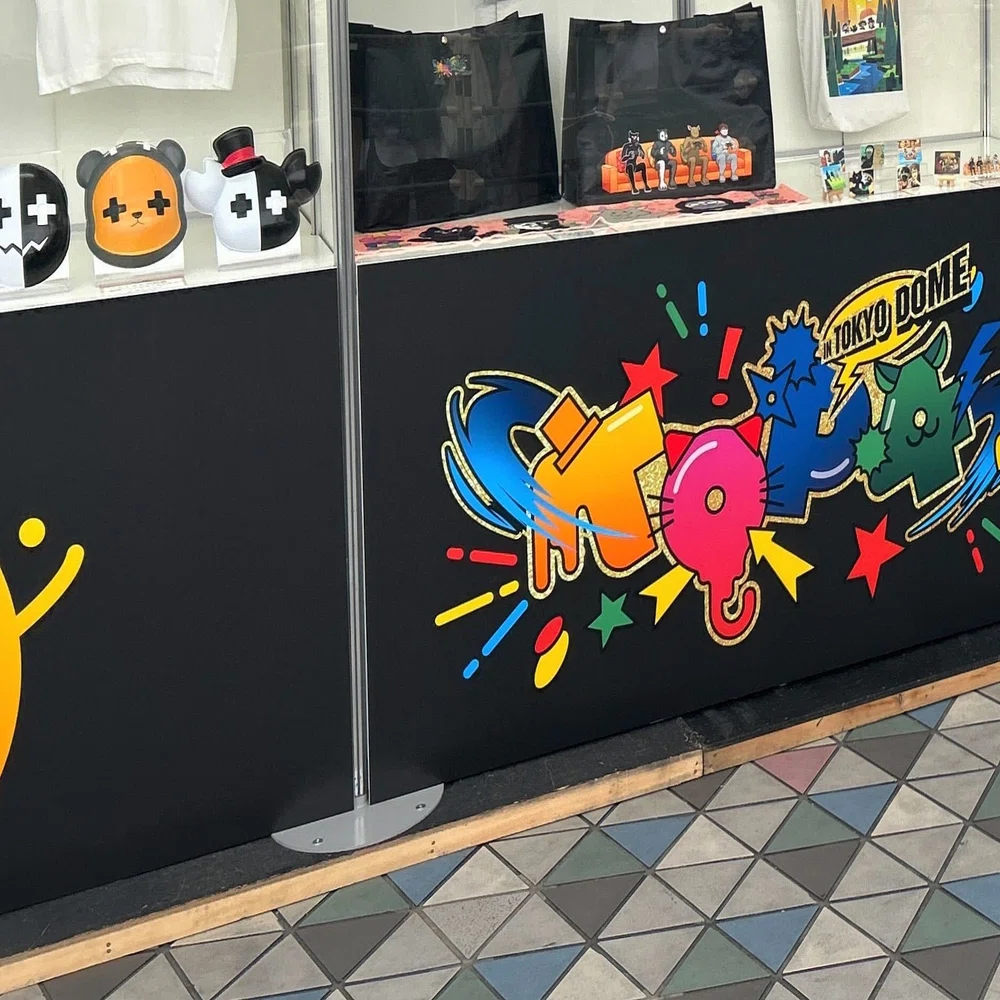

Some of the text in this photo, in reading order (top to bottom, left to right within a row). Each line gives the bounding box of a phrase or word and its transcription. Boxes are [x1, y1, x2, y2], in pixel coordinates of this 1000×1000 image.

[823, 243, 970, 360] IN TOKYO DOME
